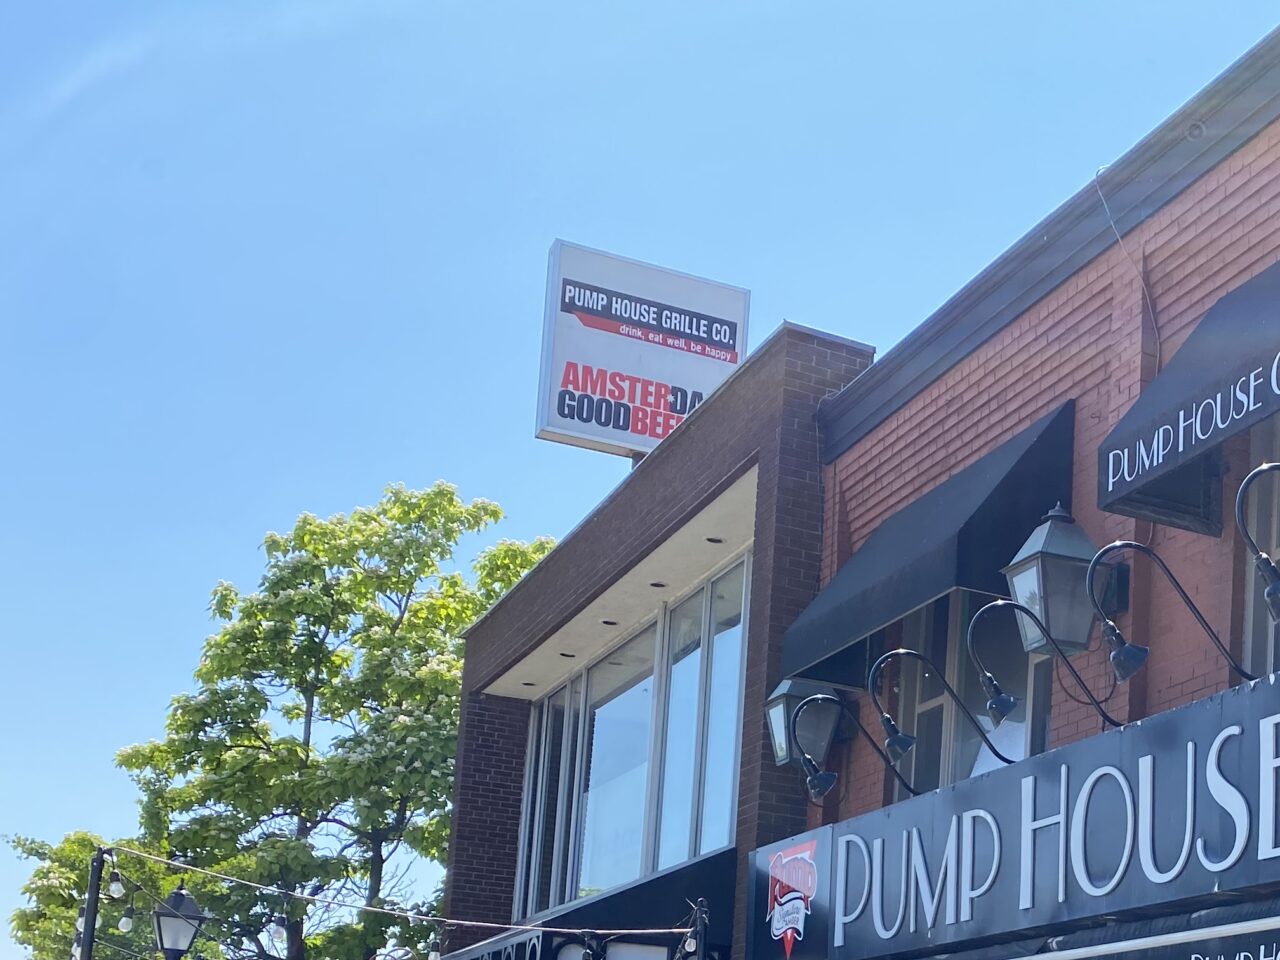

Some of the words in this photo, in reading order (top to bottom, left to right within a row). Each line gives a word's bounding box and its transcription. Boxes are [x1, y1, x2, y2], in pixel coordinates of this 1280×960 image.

[565, 285, 608, 311] PUMP
[611, 297, 658, 325] HOUSE
[661, 310, 708, 338] GRILLE
[712, 322, 734, 345] CO.
[619, 324, 645, 340] drink,
[648, 332, 663, 343] eat
[666, 337, 687, 350] well,
[690, 341, 702, 353] be
[705, 346, 732, 362] happy
[557, 389, 686, 440] GOODBEE
[561, 361, 704, 415] AMSTERDA
[1108, 425, 1174, 492] PUMP
[1178, 367, 1263, 453] HOUSE
[833, 809, 1000, 948] PUMP
